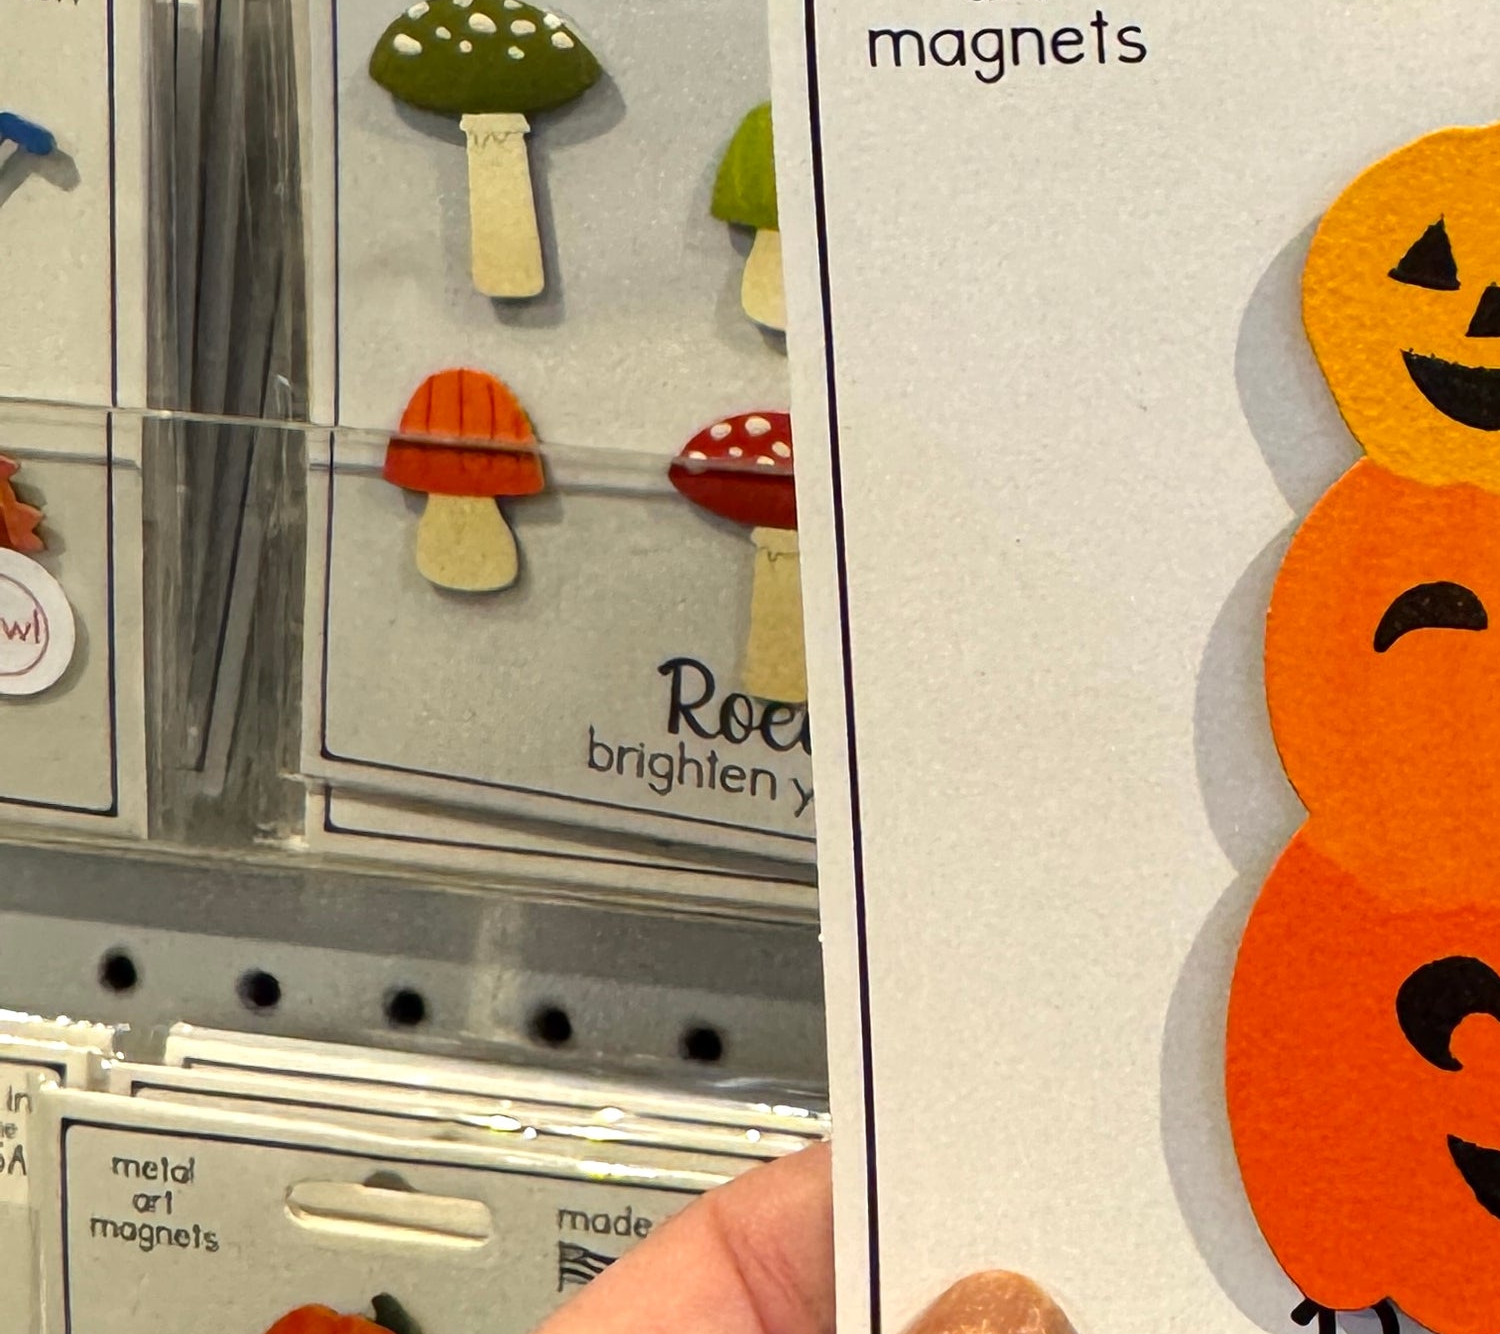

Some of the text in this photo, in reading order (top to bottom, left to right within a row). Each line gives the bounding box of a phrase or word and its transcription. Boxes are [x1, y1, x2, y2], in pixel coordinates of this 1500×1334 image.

[868, 10, 1147, 83] magnets
[588, 724, 777, 801] brighten
[112, 1156, 195, 1184] metal
[133, 1190, 172, 1215] art
[90, 1217, 220, 1252] magnets
[558, 1205, 653, 1238] made
